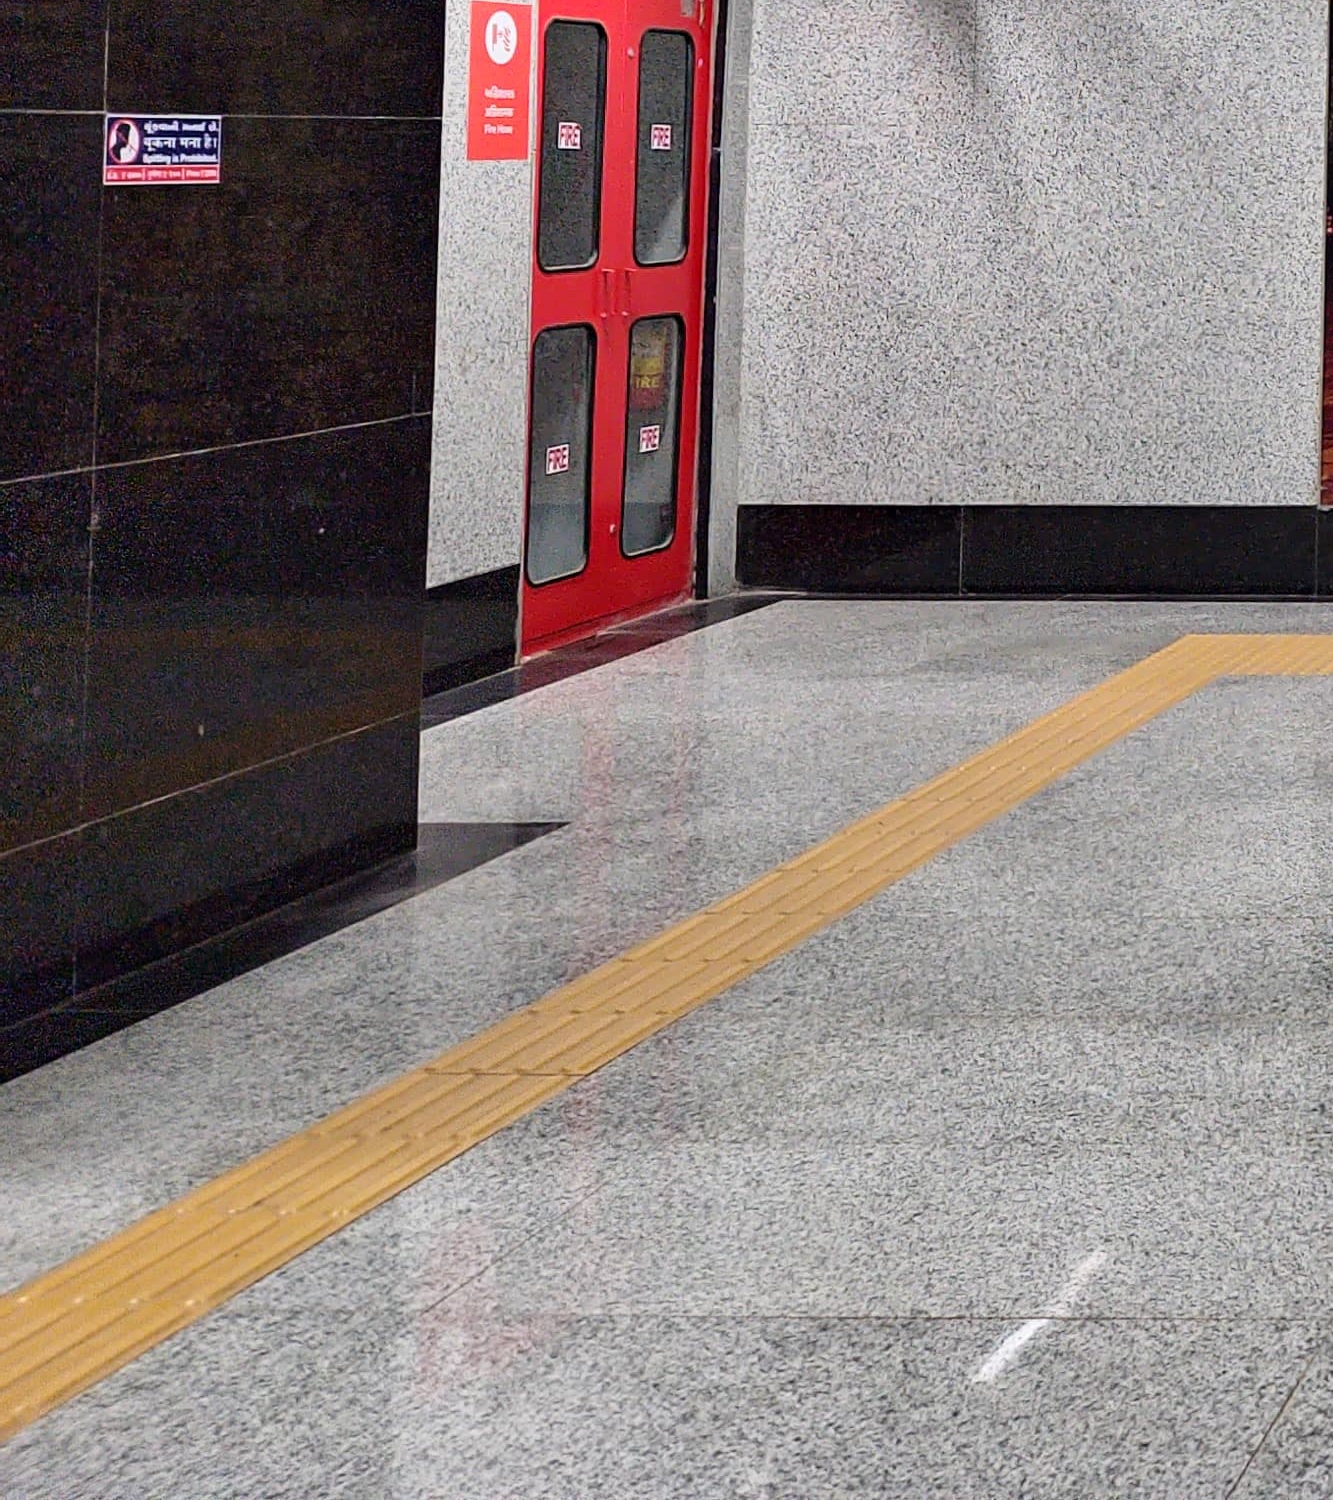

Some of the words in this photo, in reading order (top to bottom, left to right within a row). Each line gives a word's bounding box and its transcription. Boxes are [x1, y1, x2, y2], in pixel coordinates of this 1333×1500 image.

[560, 124, 580, 147] FIRE
[652, 126, 670, 148] FIRE
[641, 427, 659, 449] FIRE
[548, 446, 568, 470] FIRE
